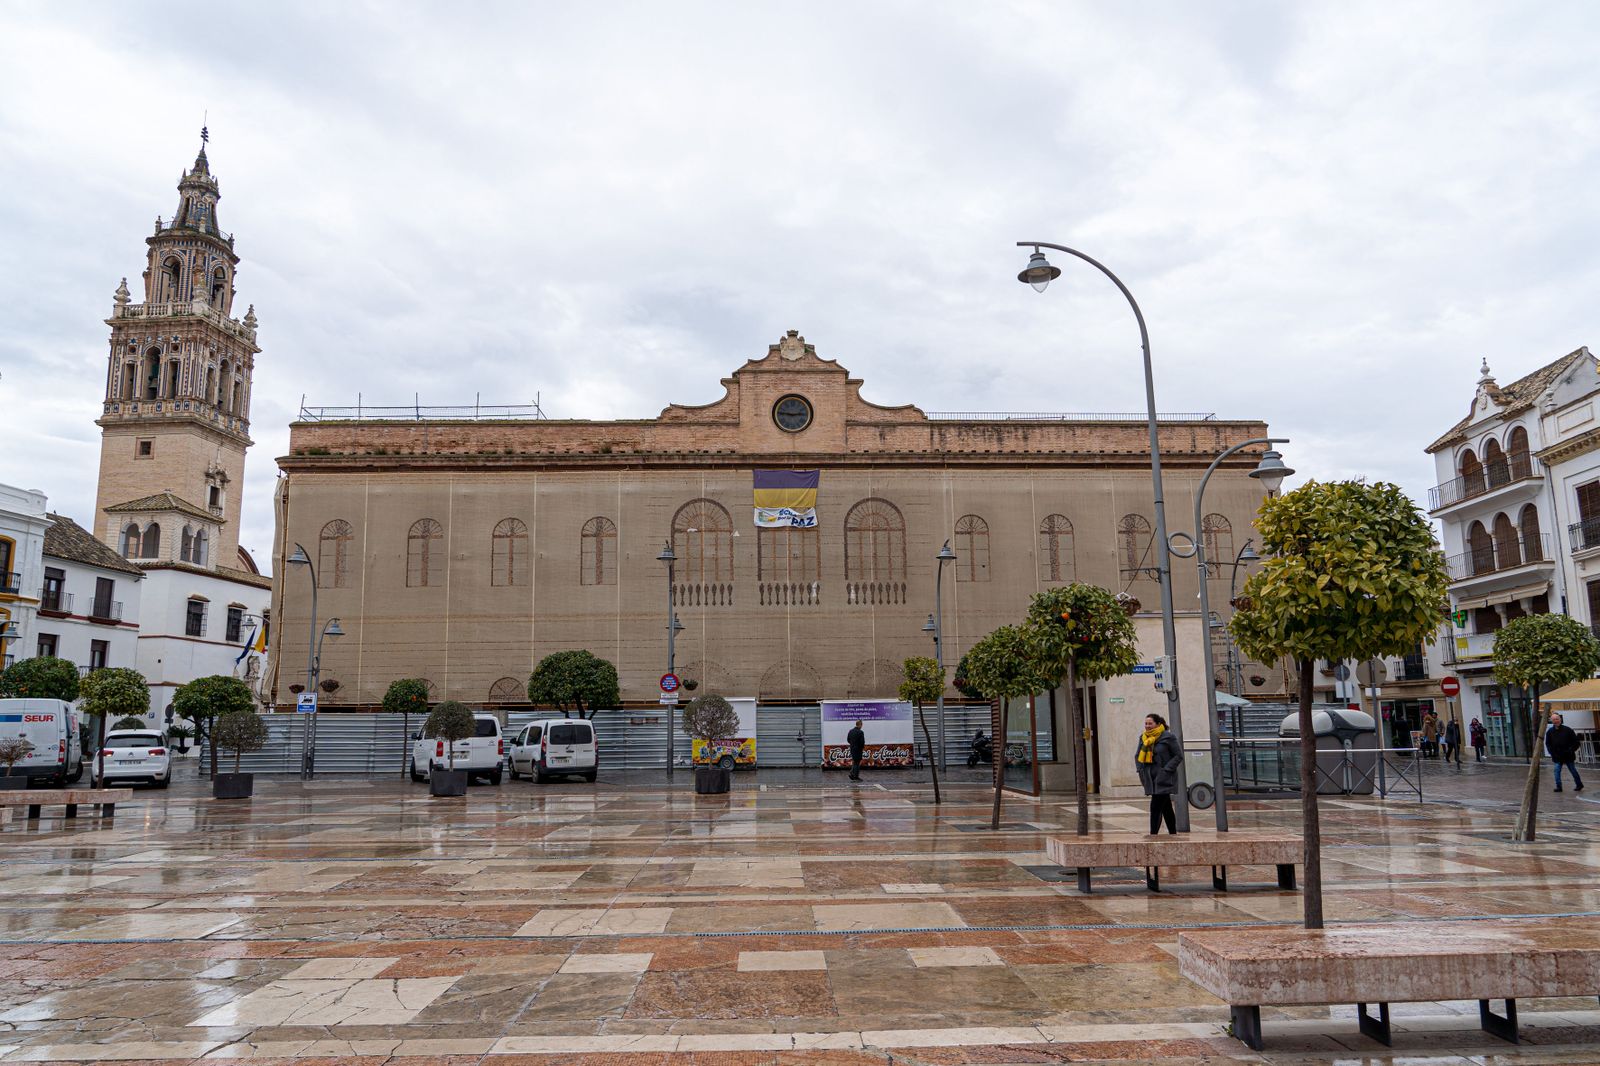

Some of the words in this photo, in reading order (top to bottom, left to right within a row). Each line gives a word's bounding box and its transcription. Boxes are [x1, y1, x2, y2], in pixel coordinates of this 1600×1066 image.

[791, 516, 815, 527] PAZ
[24, 714, 54, 723] SEUR
[872, 745, 910, 762] Asadas
